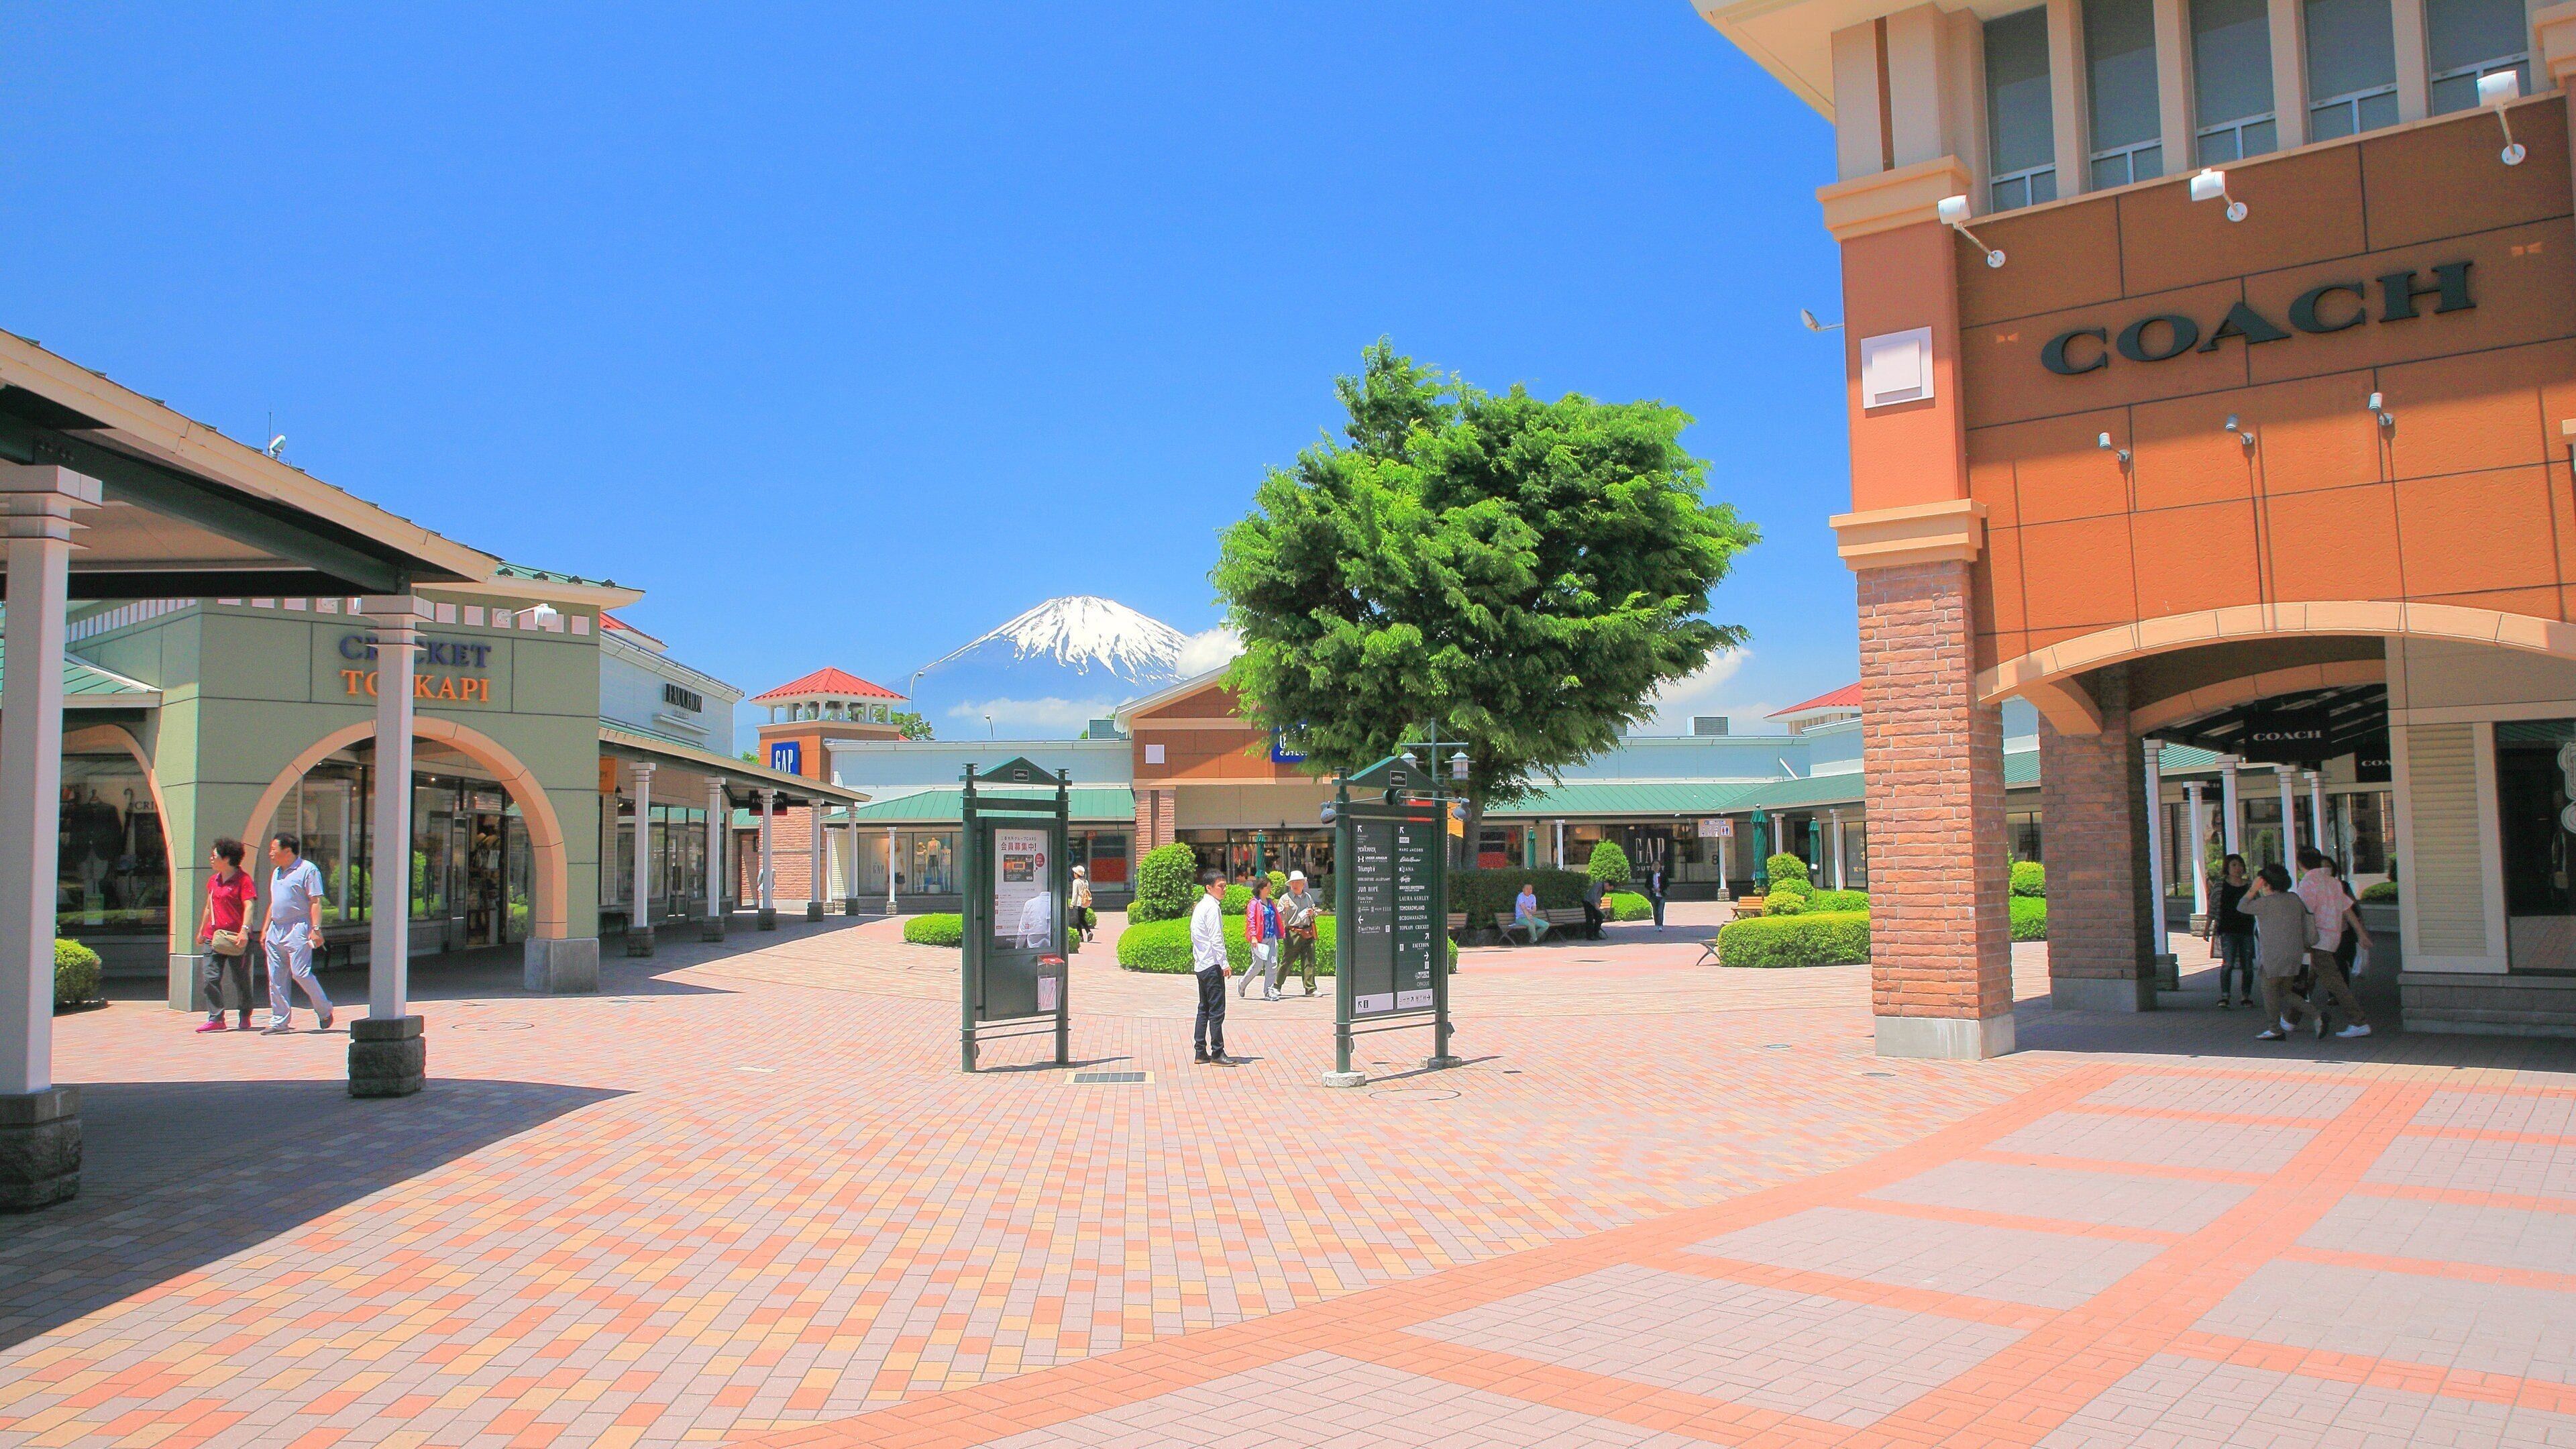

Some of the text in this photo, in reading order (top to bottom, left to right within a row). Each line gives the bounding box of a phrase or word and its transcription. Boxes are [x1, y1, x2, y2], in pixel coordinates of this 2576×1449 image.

[2041, 260, 2477, 375] COACH
[339, 669, 490, 702] TOKAPI
[2253, 730, 2322, 741] COACH
[775, 749, 794, 773] GAP
[1635, 838, 1665, 863] GAP
[873, 864, 884, 874] GAP
[1357, 865, 1373, 873] Triumph
